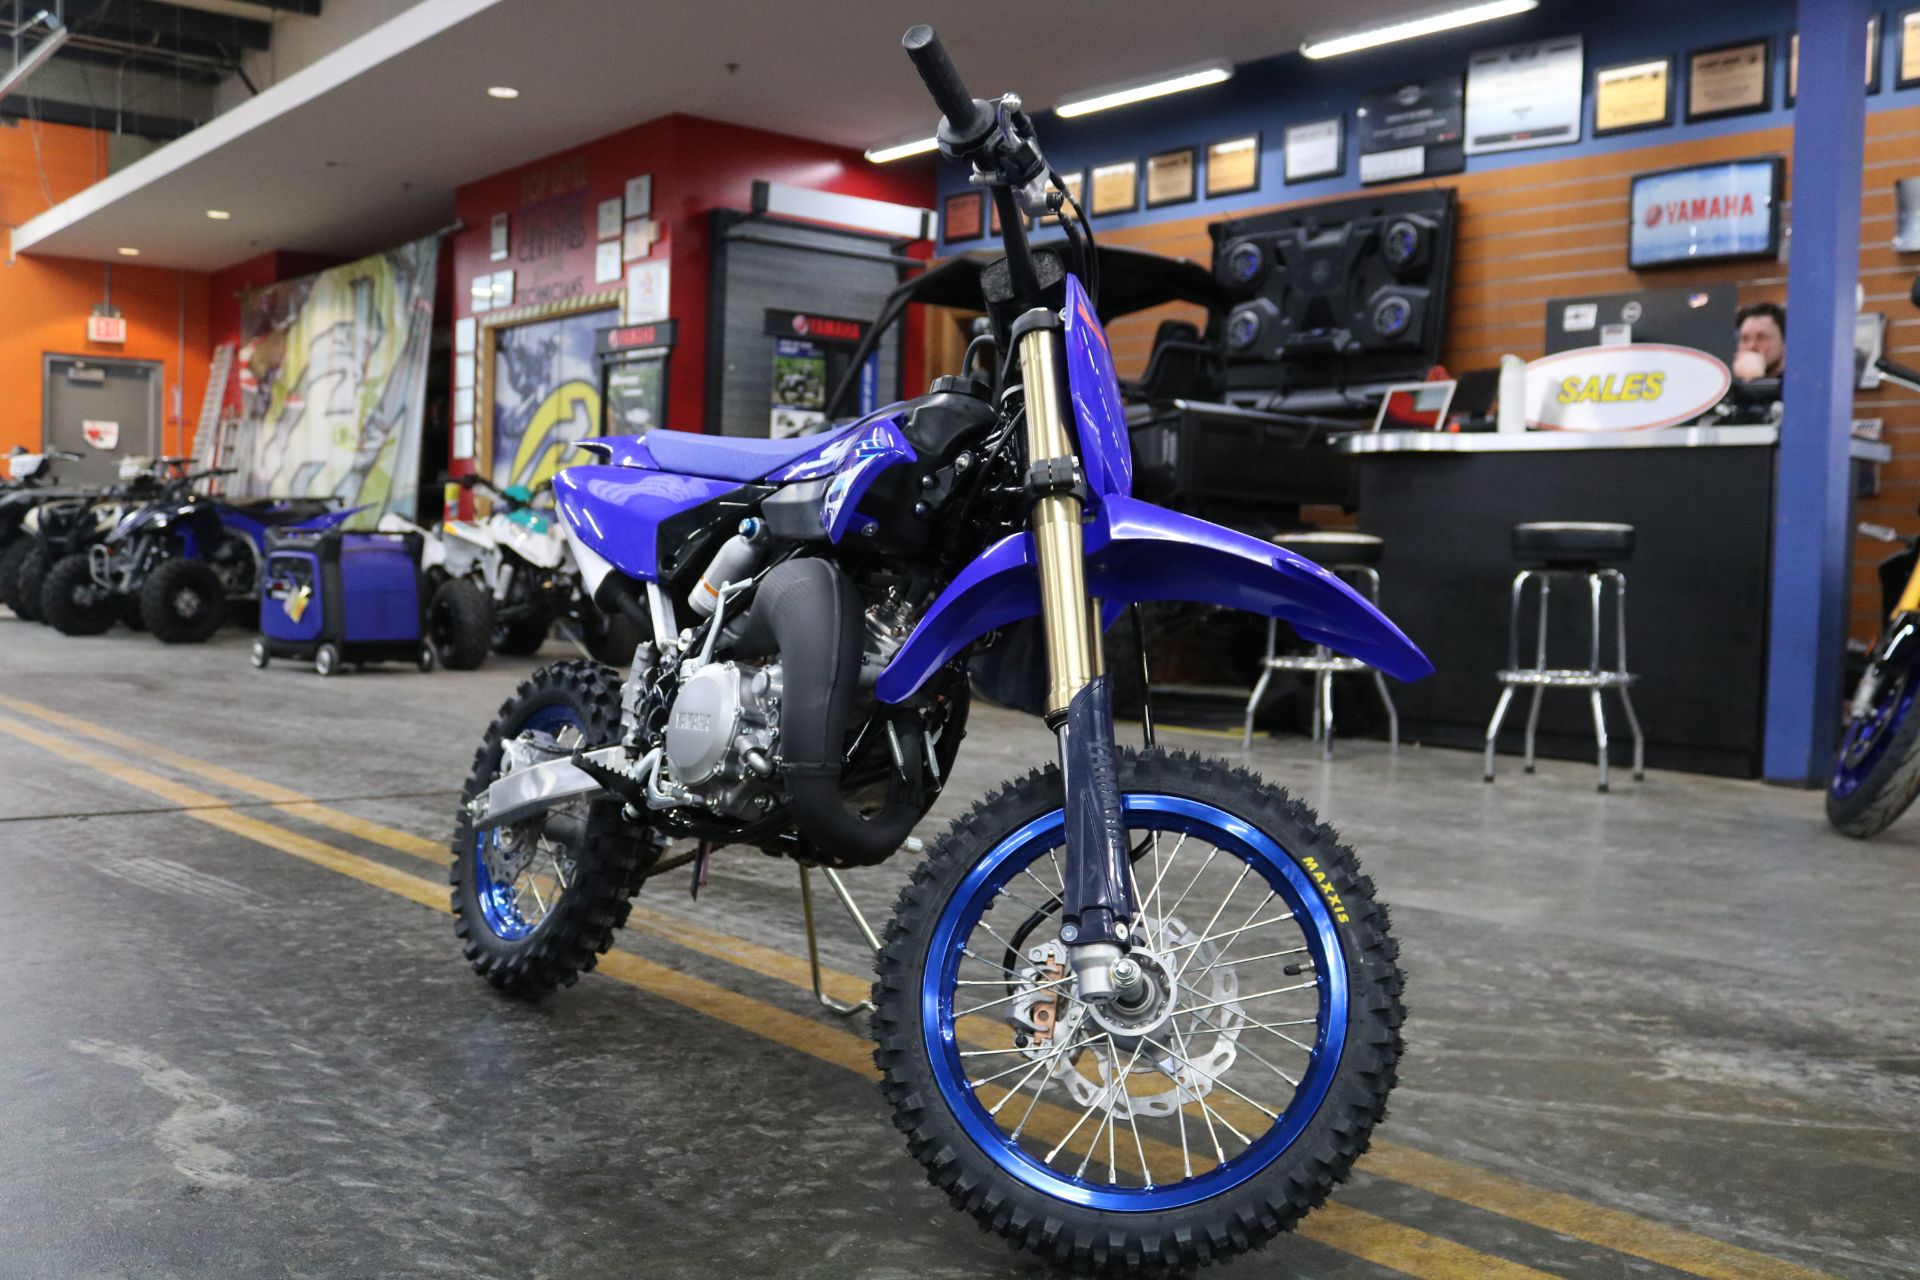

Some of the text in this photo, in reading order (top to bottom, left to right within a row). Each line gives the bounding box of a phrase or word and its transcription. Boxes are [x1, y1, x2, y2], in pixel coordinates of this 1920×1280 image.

[1666, 193, 1754, 224] YAMAHA
[807, 318, 861, 340] YAMAHA
[1557, 371, 1666, 404] SALES
[1302, 856, 1350, 923] MAXXIS
